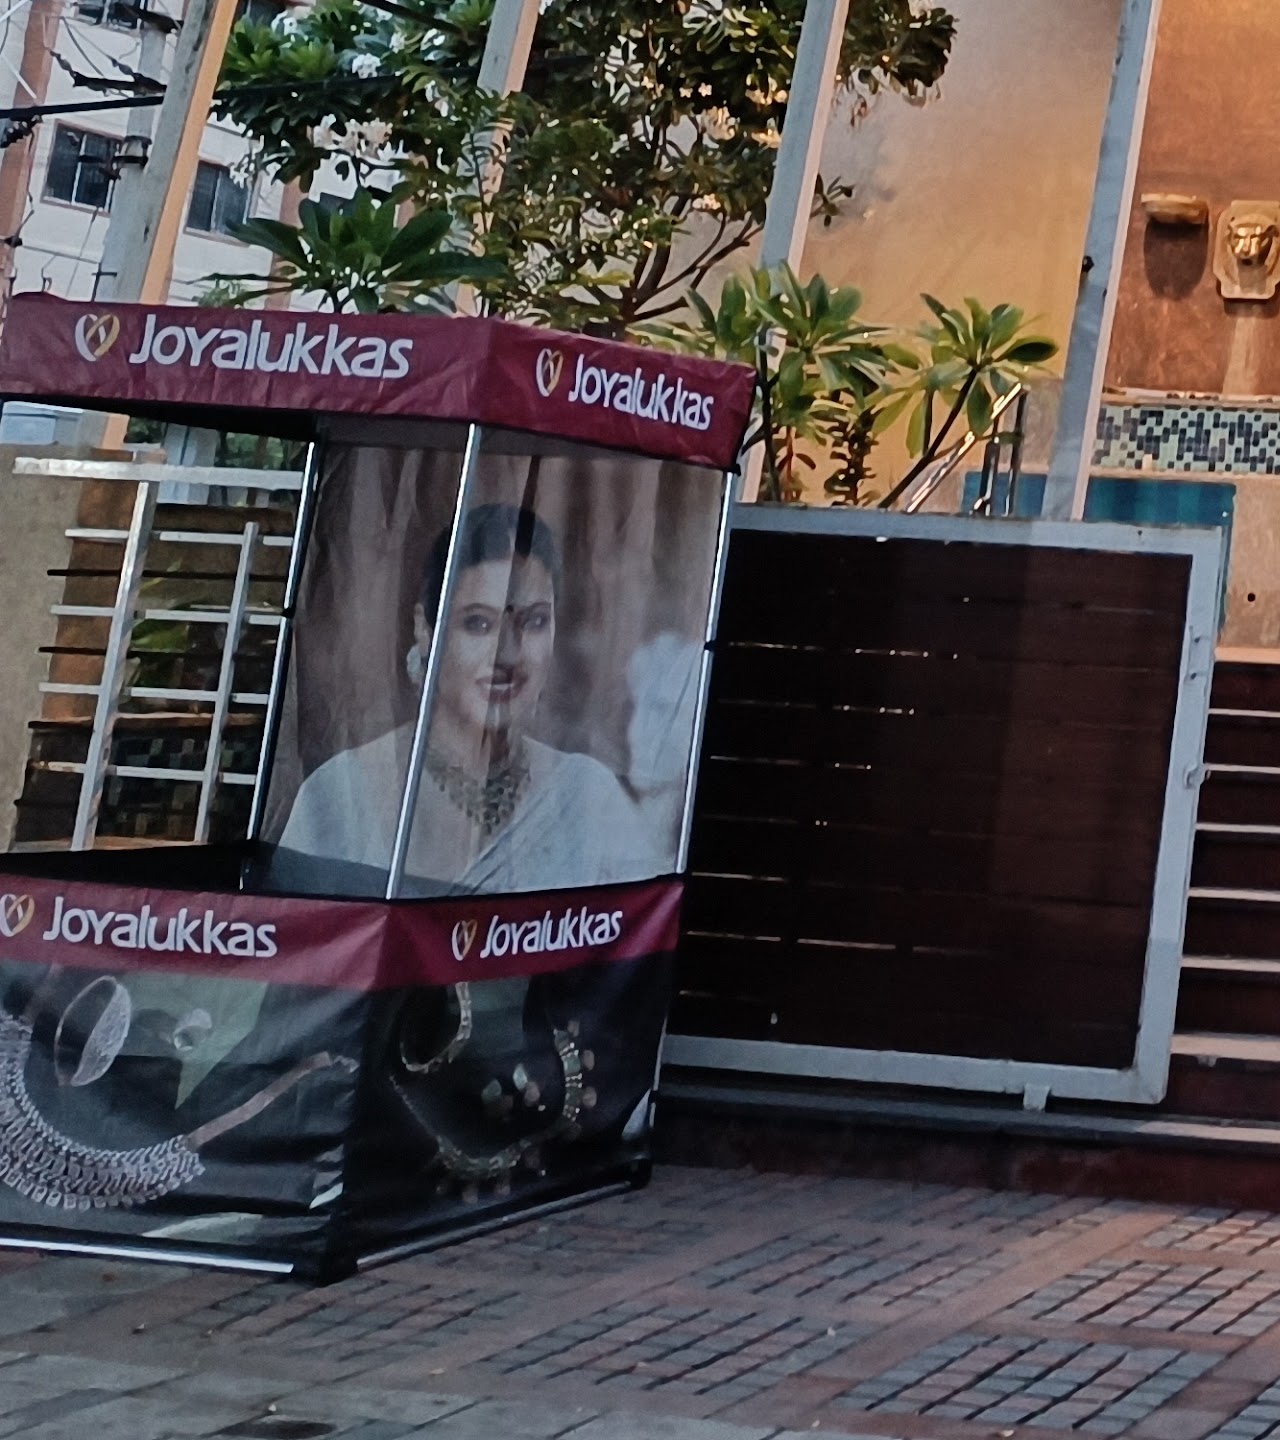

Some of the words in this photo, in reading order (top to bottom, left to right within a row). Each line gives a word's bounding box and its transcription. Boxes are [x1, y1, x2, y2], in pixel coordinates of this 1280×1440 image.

[129, 315, 413, 379] Joyalukkas
[568, 355, 714, 431] Joyalukkas
[43, 895, 278, 958] Joyalukkas
[479, 906, 624, 959] Joyalukkas
